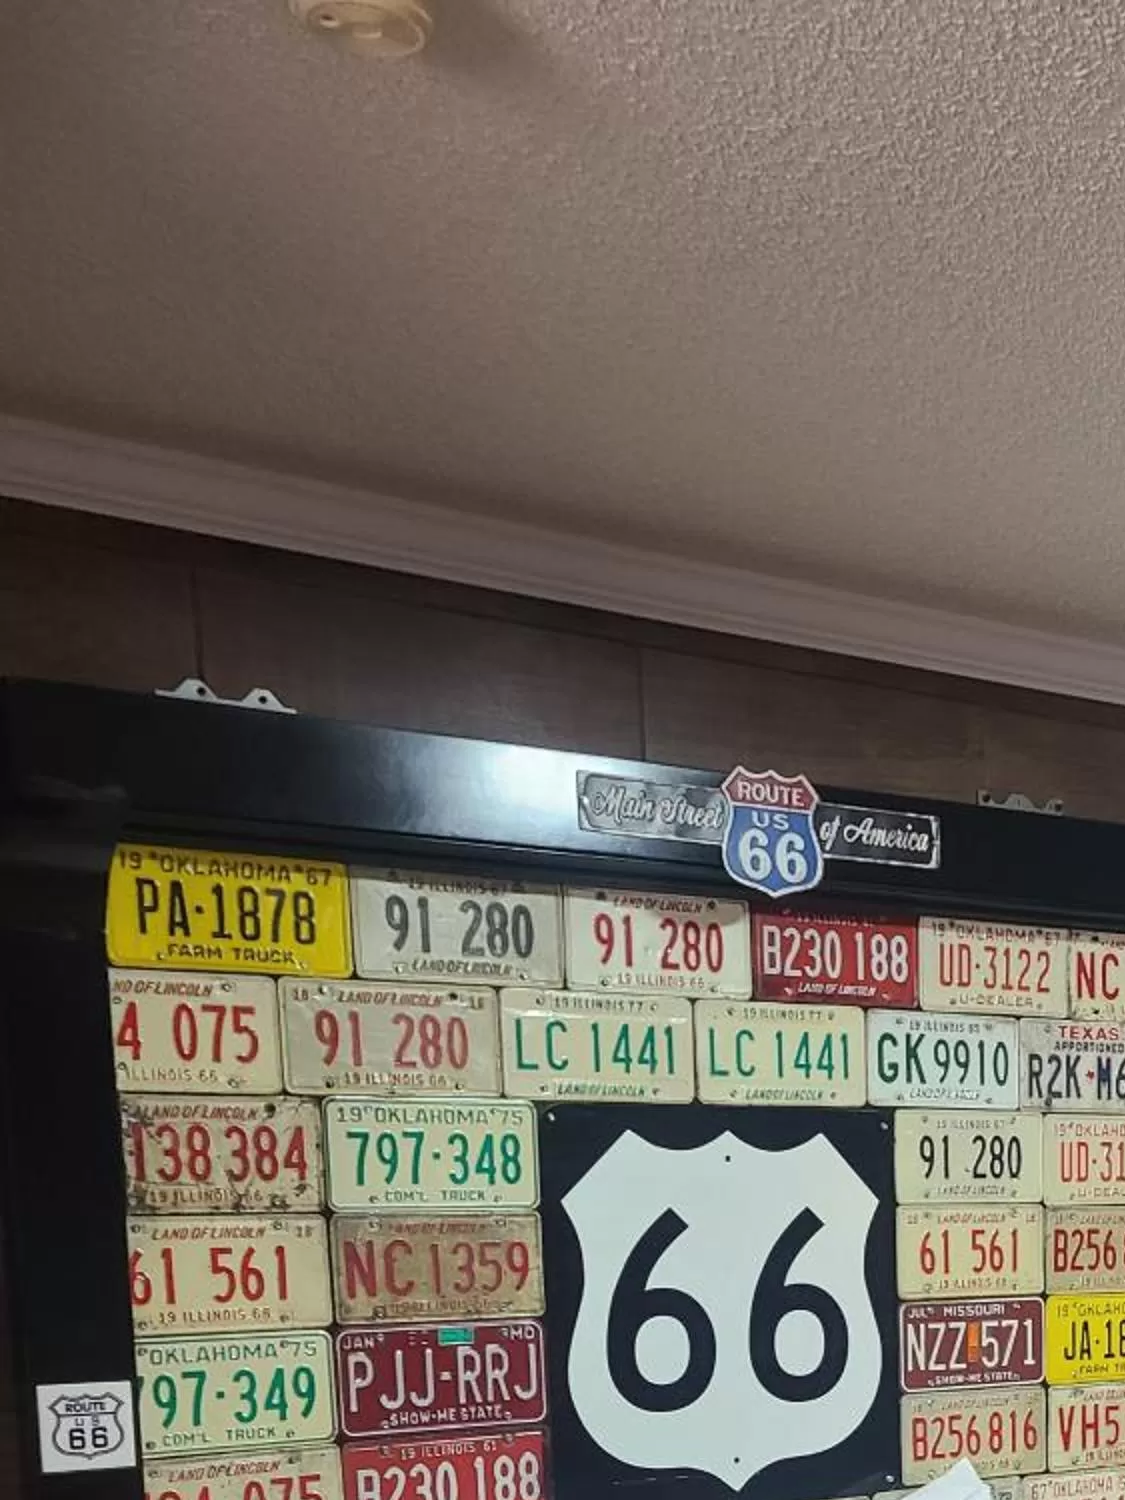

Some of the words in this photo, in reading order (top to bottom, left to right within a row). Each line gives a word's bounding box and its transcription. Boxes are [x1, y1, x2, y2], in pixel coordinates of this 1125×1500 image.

[738, 781, 805, 806] ROUTE
[591, 784, 654, 823] Main
[658, 789, 725, 829] Street
[751, 812, 789, 830] US
[820, 815, 842, 851] of
[843, 818, 929, 851] America
[739, 829, 808, 883] 66
[119, 852, 142, 869] 19
[160, 854, 292, 884] OKLAHOMA
[306, 869, 332, 886] 67
[385, 894, 430, 953] 91
[458, 899, 534, 959] 280
[958, 924, 1035, 944] OKLAHOMA
[593, 912, 633, 967] 91
[660, 917, 724, 972] 280
[167, 943, 222, 960] FARM
[232, 947, 295, 964] TRUCK
[762, 925, 842, 980] B230
[855, 931, 908, 983] 188
[134, 981, 154, 994] OF
[154, 982, 213, 997] LINCOLN
[636, 973, 684, 988] ILLINOIS
[799, 983, 824, 993] LAND
[571, 997, 624, 1012] ILLINOIS
[759, 1008, 805, 1021] ILLINOIS
[116, 1001, 141, 1061] 4
[173, 1003, 259, 1064] 075
[315, 1009, 363, 1067] 91
[392, 1013, 468, 1070] 280
[1058, 1025, 1120, 1040] TEXAS
[515, 1017, 569, 1070] LC
[591, 1022, 675, 1075] 1441
[709, 1027, 756, 1077] LC
[776, 1030, 849, 1080] 1441
[1054, 1041, 1125, 1053] APPORTIONED
[124, 1067, 192, 1081] ILLINOIS
[365, 1073, 424, 1086] ILLINOIS
[201, 1105, 259, 1121] LINCOLN
[337, 1107, 362, 1123] 19
[375, 1107, 488, 1124] OKLAHOMA
[501, 1109, 523, 1125] 75
[131, 1123, 212, 1183] 138
[224, 1125, 308, 1183] 384
[919, 1135, 949, 1179] 91
[972, 1135, 1022, 1179] 280
[440, 1190, 486, 1201] TRUCK
[152, 1228, 188, 1241] LAND
[191, 1227, 209, 1240] OF
[210, 1226, 266, 1239] LINCOLN
[920, 1228, 949, 1275] 61
[971, 1228, 1017, 1273] 561
[129, 1248, 176, 1306] 61
[209, 1246, 288, 1303] 561
[159, 1312, 176, 1326] 19
[183, 1309, 245, 1322] ILLINOIS
[606, 1206, 849, 1413] 66
[944, 1305, 1005, 1317] MISSOURI
[342, 1336, 375, 1350] JAN
[510, 1327, 535, 1340] MO
[981, 1320, 1036, 1368] 571
[150, 1344, 277, 1365] OKLAHOMA
[292, 1341, 317, 1357] 75
[985, 1371, 1016, 1382] STATE
[65, 1401, 106, 1412] ROUTE
[461, 1404, 501, 1421] STATE
[69, 1427, 108, 1450] 66
[226, 1427, 276, 1441] TRUCK
[421, 1442, 476, 1458] ILLINOIS
